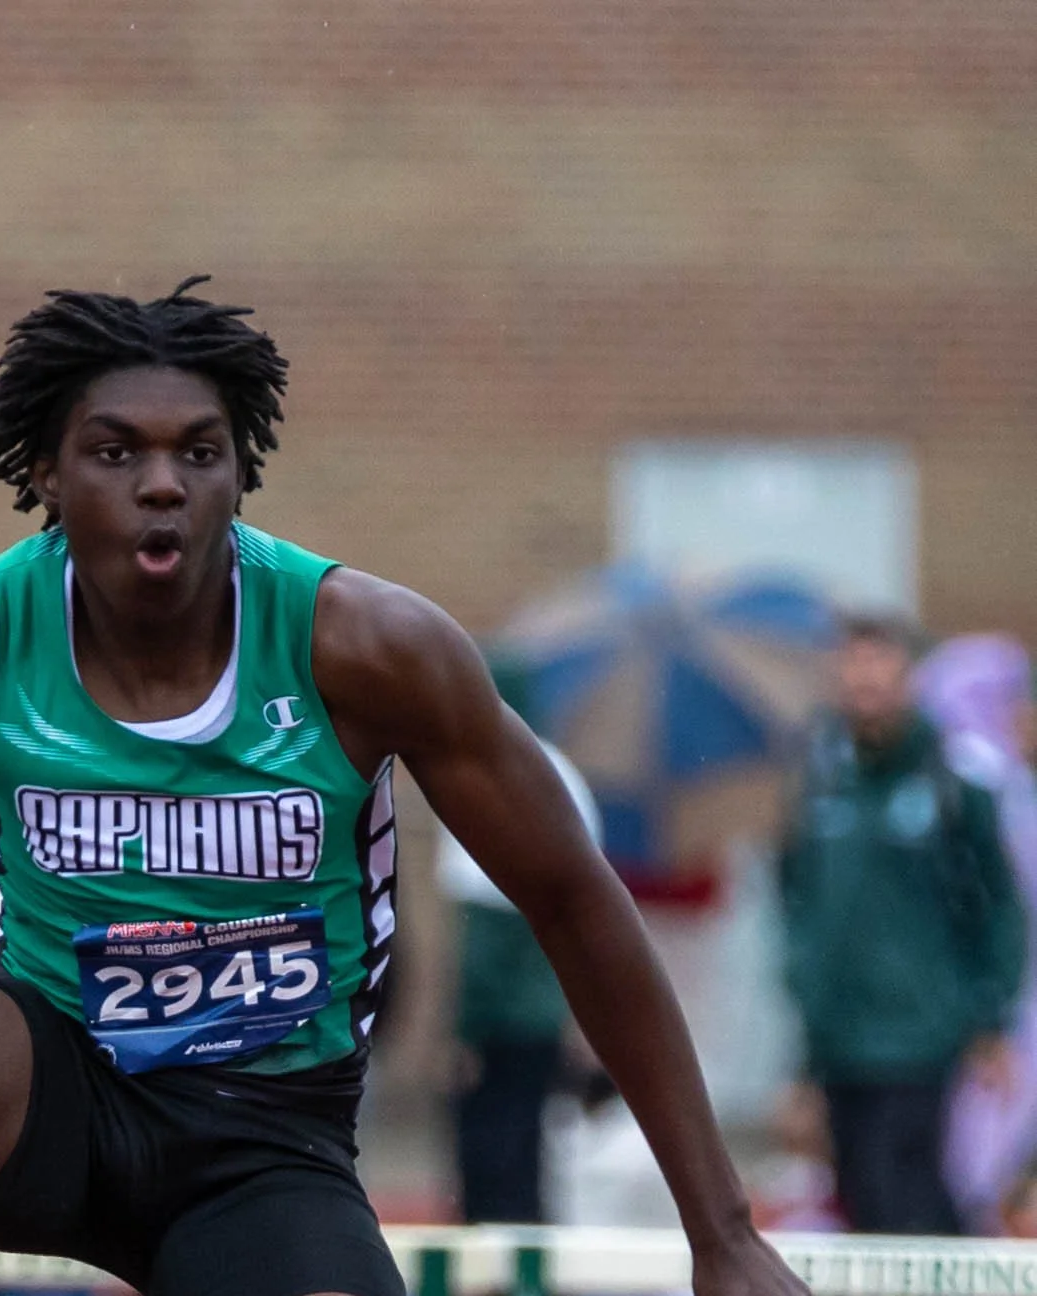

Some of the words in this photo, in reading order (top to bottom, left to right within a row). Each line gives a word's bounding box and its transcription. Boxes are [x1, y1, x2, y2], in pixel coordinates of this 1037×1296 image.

[16, 786, 324, 882] CAPTAINS
[145, 938, 204, 956] REGIONAL
[207, 923, 298, 946] CHAMPIONSHIP
[94, 940, 319, 1023] 2945
